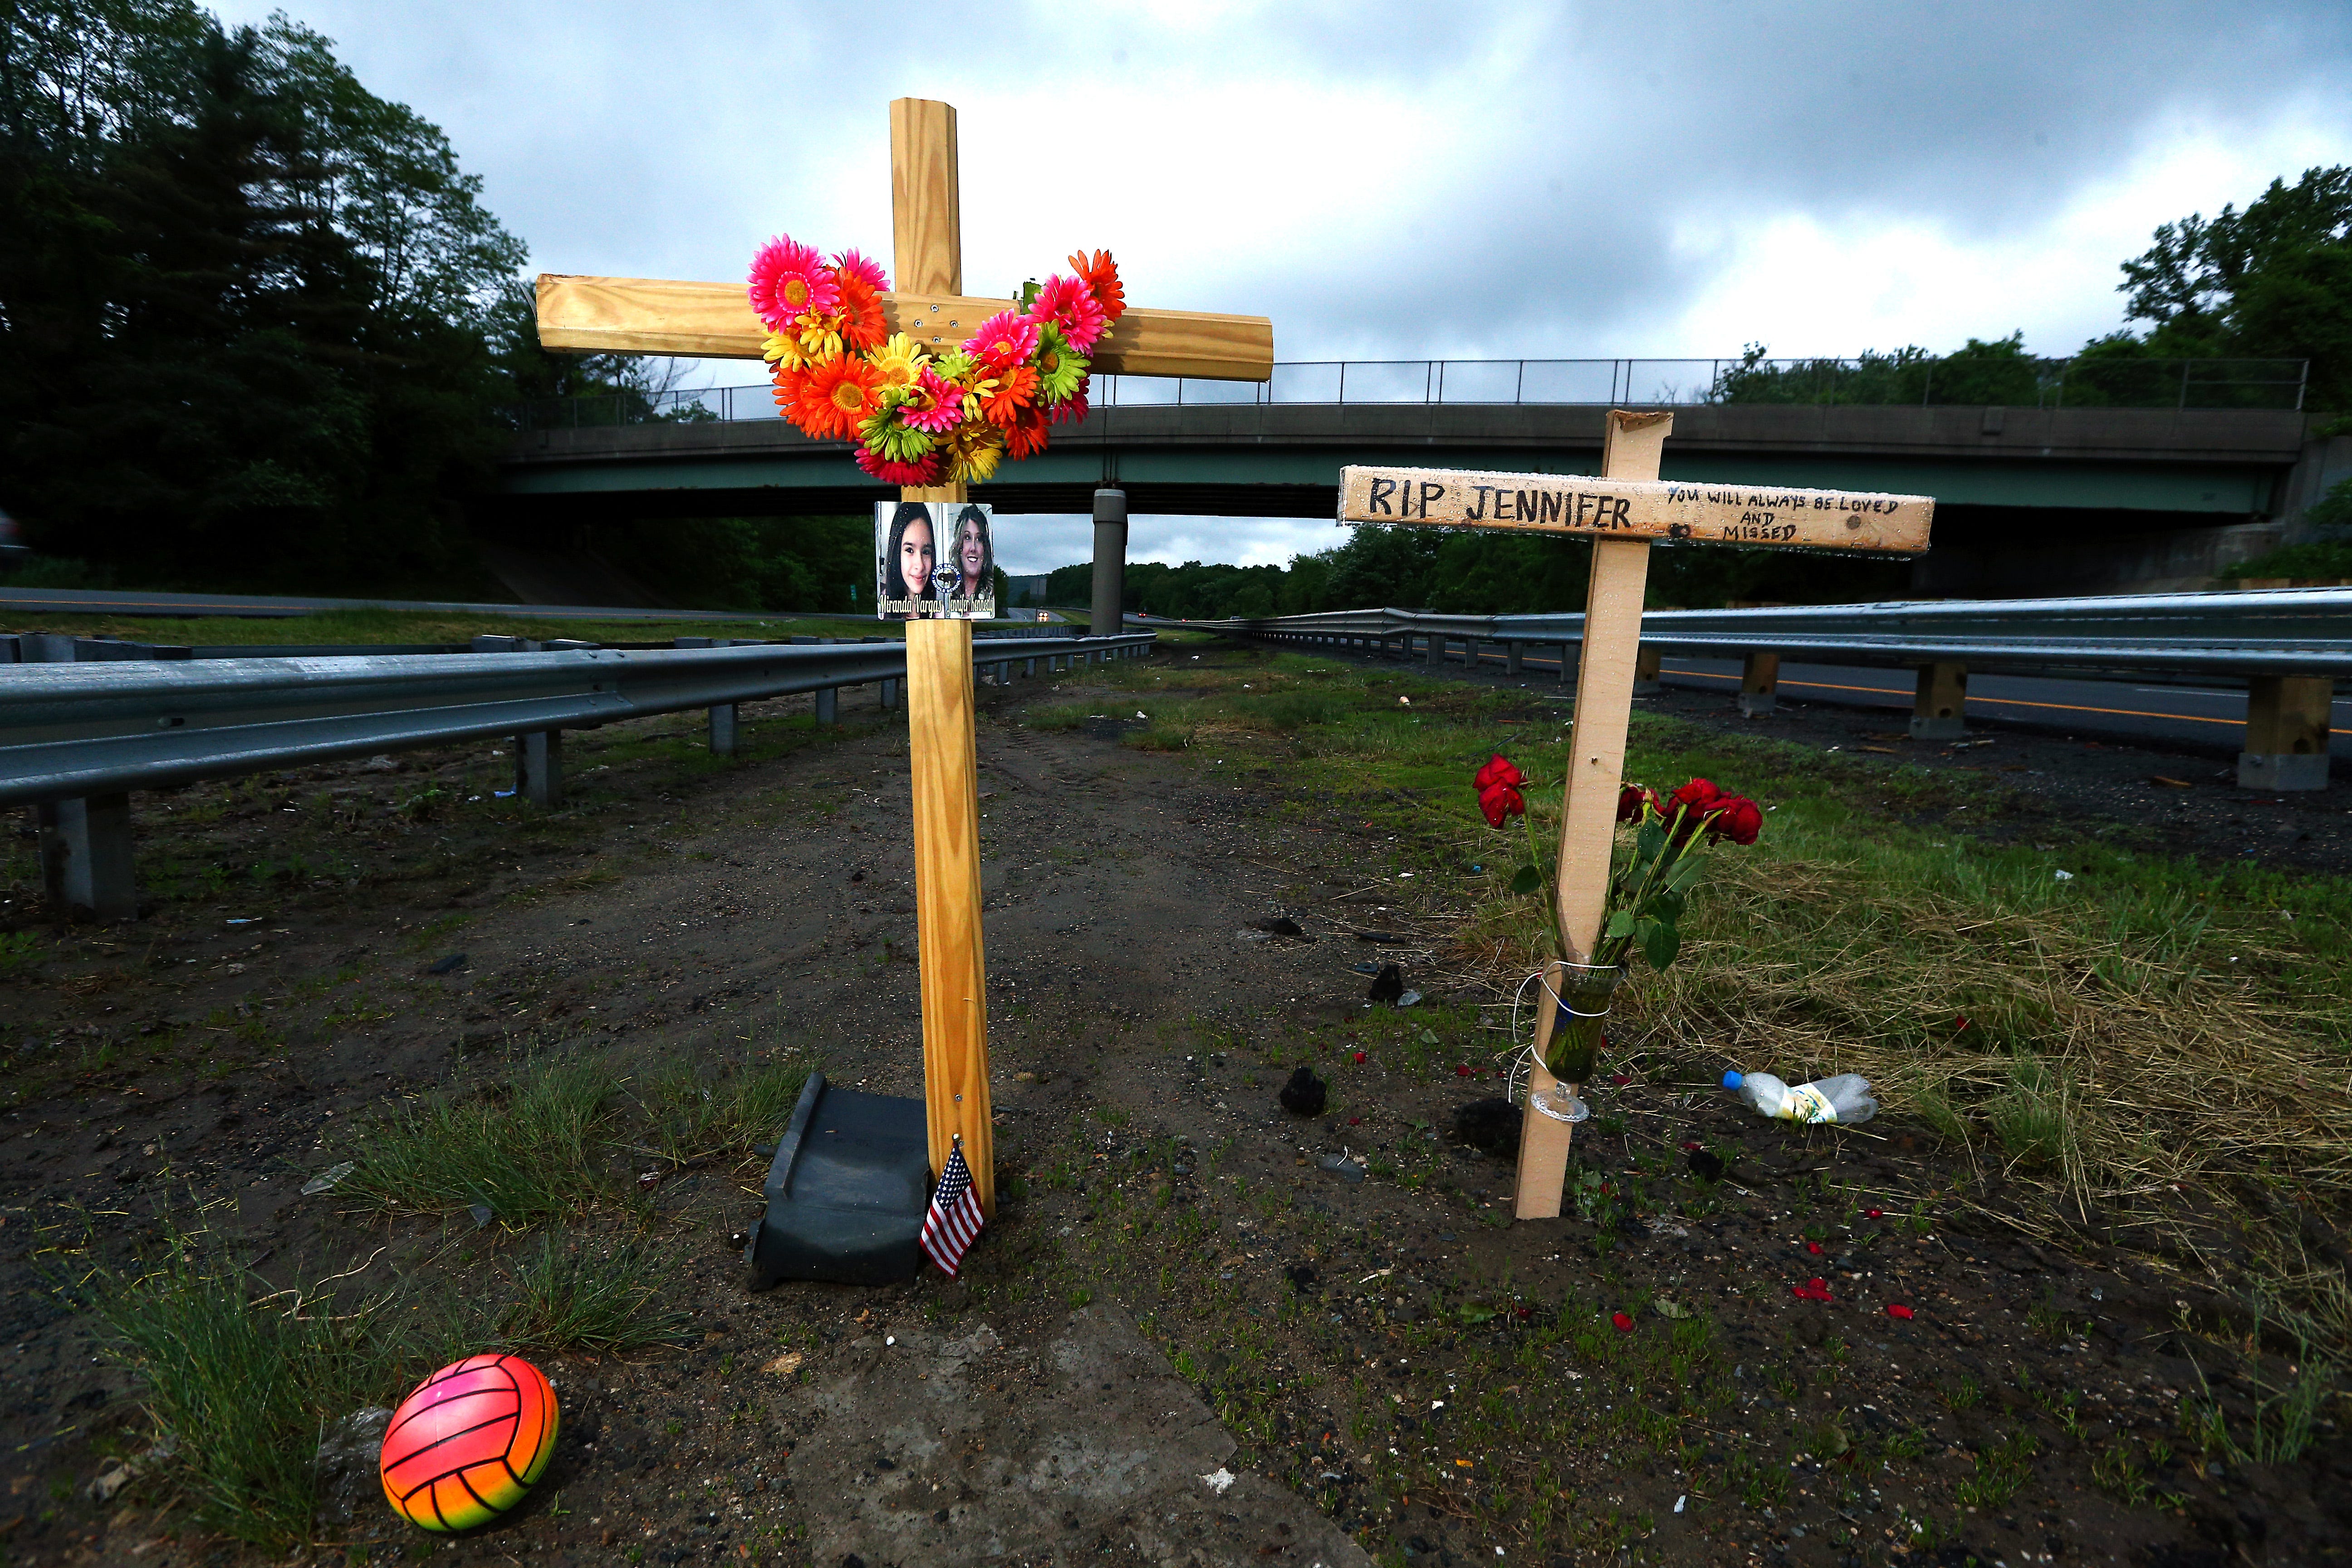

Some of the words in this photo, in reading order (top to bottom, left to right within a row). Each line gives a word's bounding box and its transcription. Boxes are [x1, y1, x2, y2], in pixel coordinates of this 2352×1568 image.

[1370, 478, 1446, 519] RIP
[1466, 486, 1631, 530] JENNIFER
[1668, 486, 1699, 505] YOU
[1707, 491, 1742, 505] WILL
[1748, 494, 1806, 511] ALWAYS
[1740, 511, 1775, 528] AND
[1723, 524, 1796, 541] MISSED
[932, 564, 942, 575] EAST
[944, 564, 960, 576] BROOK
[932, 579, 946, 593] MIDDLE
[946, 579, 961, 593] SCHOOL
[879, 594, 912, 613] Miranda
[914, 594, 941, 618] Vargas
[947, 593, 969, 617] Jennifer
[970, 593, 994, 617] Kennedy
